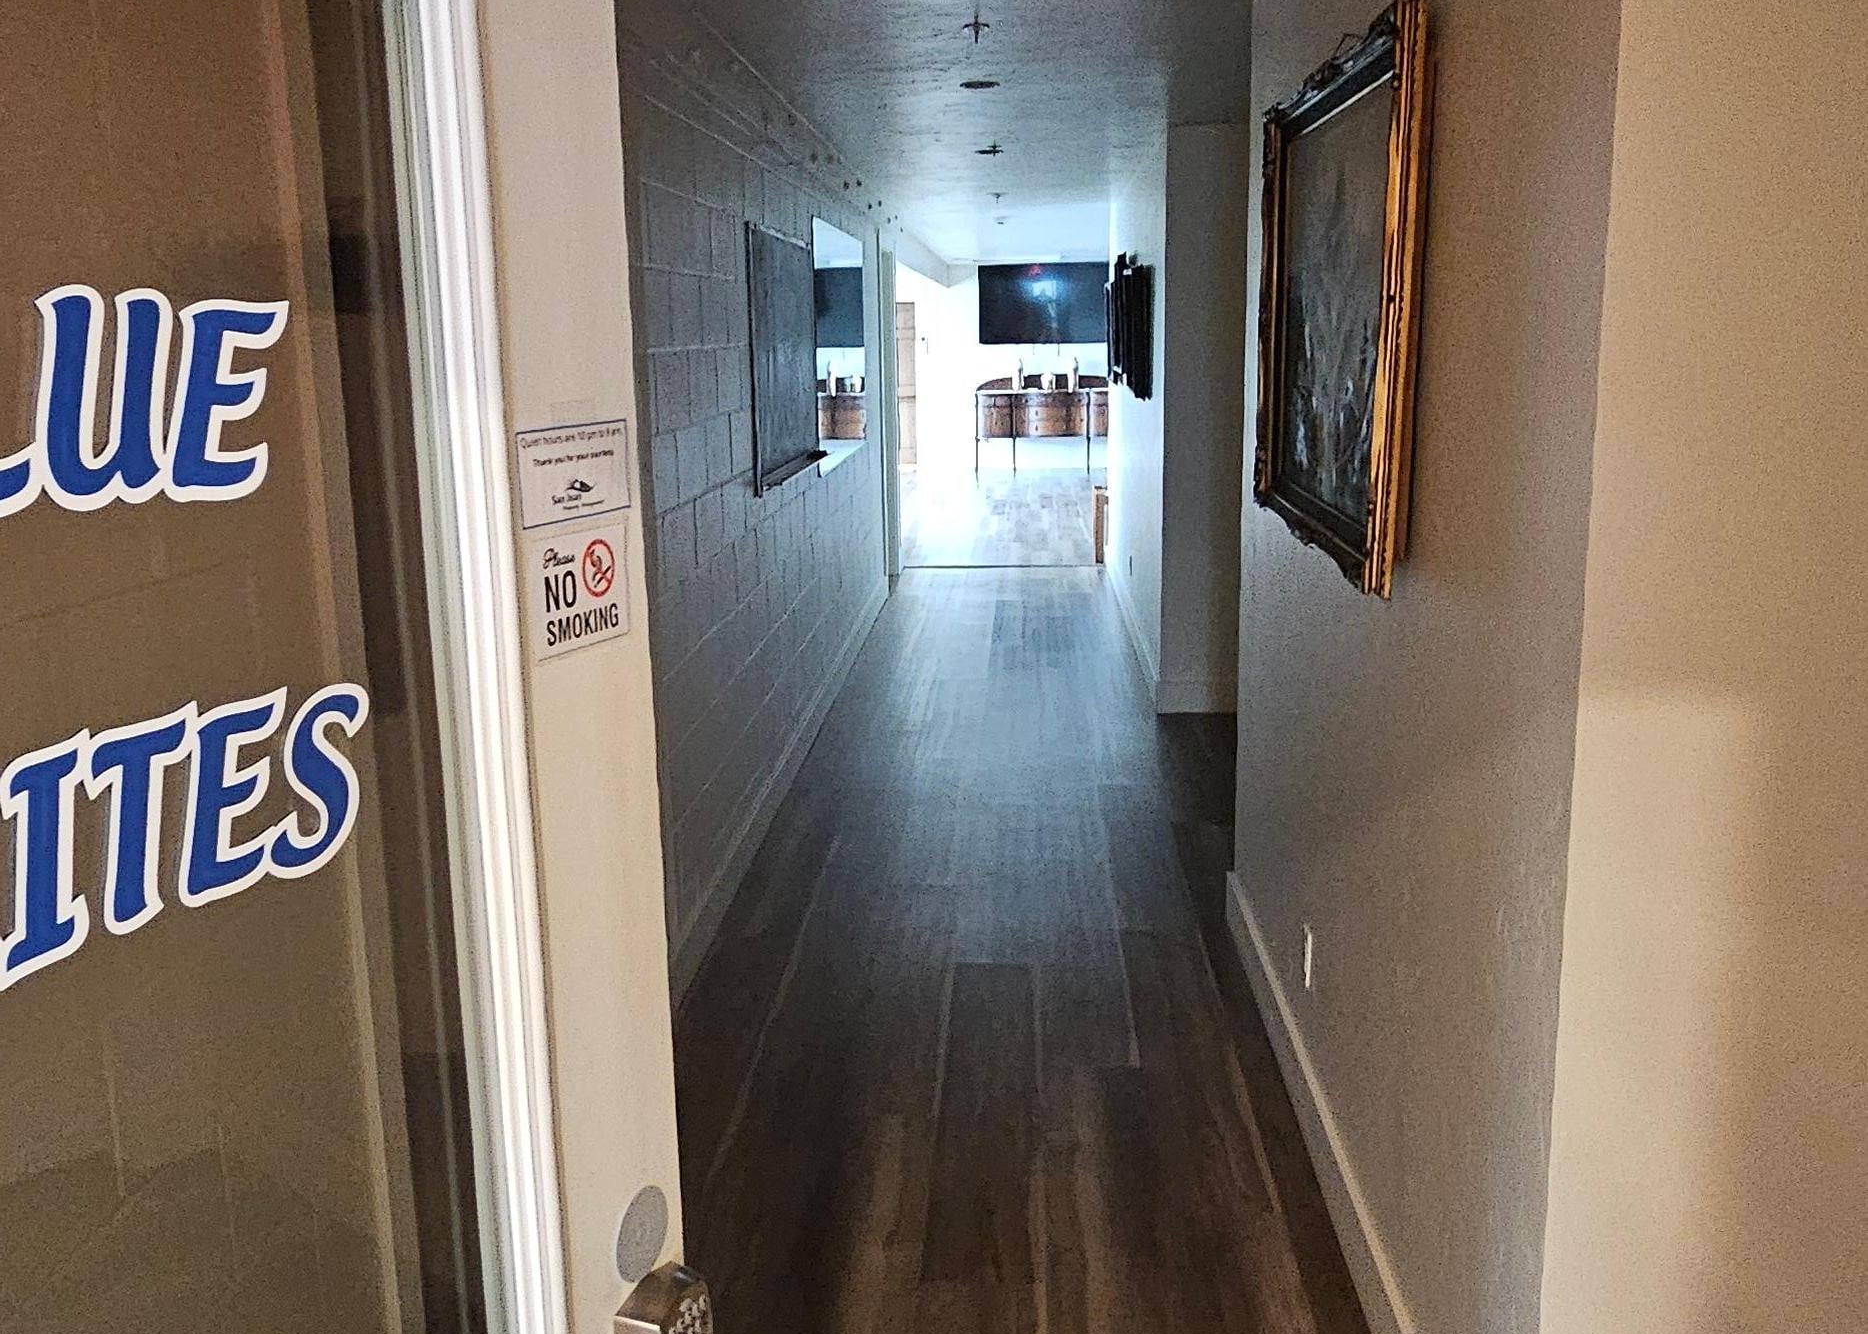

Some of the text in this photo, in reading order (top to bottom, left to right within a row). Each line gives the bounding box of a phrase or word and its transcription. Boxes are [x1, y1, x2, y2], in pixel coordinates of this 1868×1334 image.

[520, 437, 541, 449] Quiet
[543, 435, 563, 446] hours
[532, 458, 553, 467] Thank
[551, 494, 566, 505] San
[544, 570, 576, 613] NO
[547, 603, 619, 647] SMOKING
